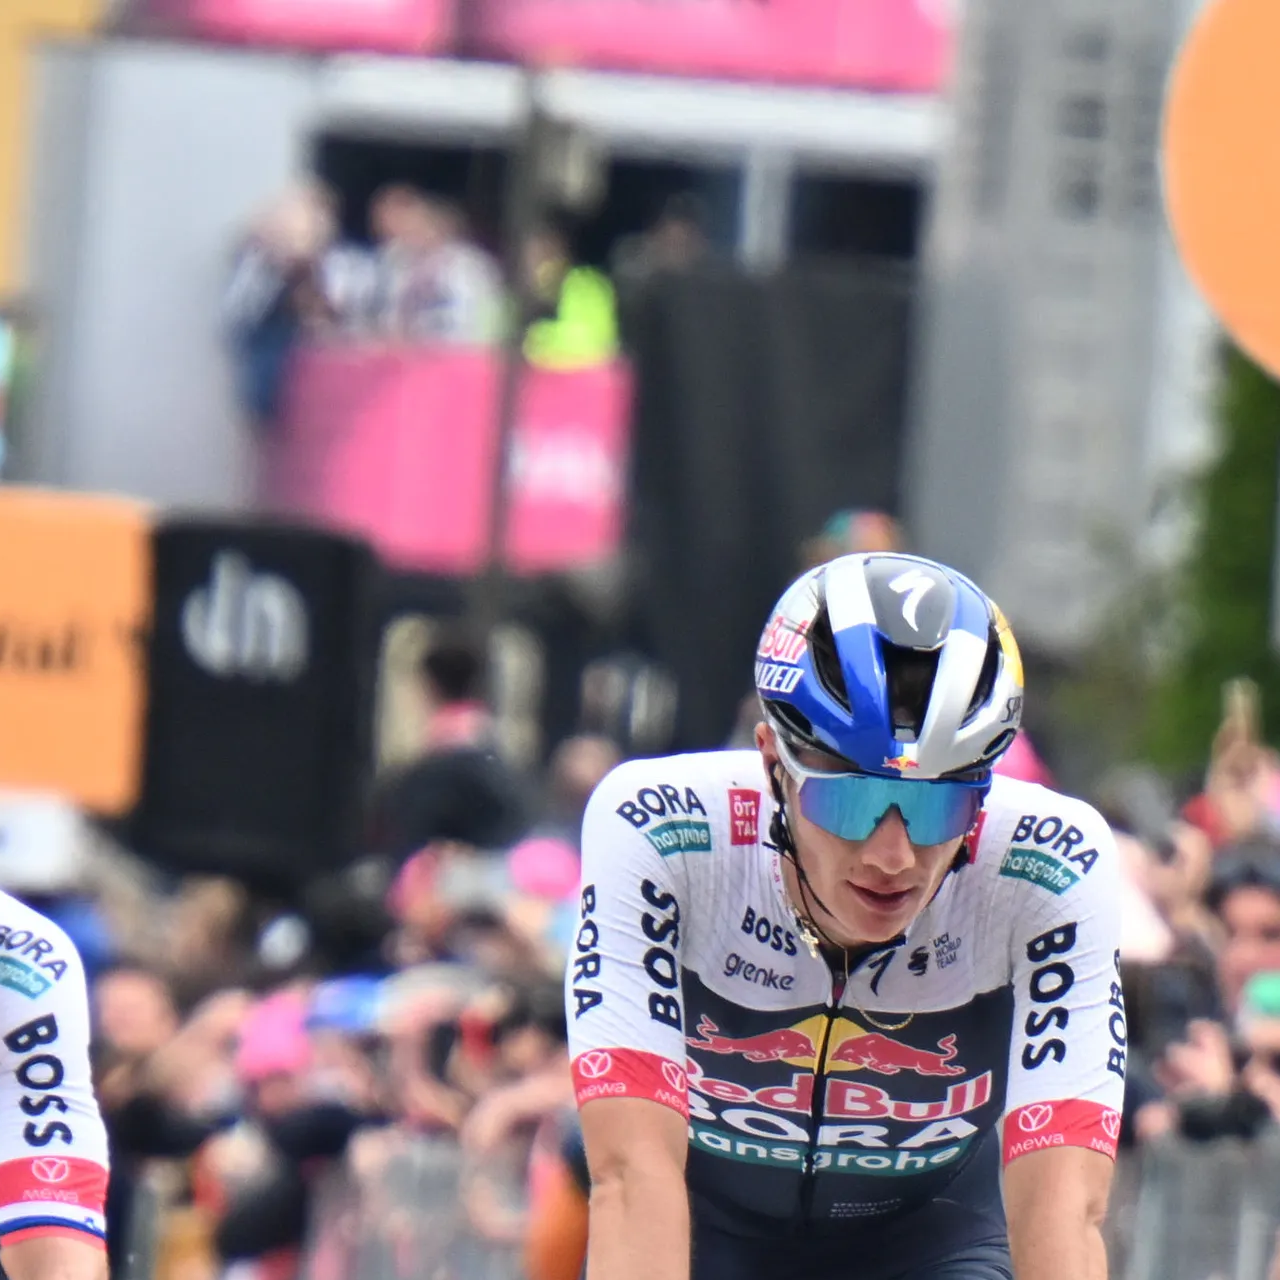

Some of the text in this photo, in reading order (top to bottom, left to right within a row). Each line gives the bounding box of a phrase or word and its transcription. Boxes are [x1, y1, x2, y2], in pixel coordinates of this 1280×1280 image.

[616, 783, 708, 829] BORA
[1012, 814, 1100, 875] BORA
[571, 884, 604, 1020] BORA
[641, 878, 682, 1031] BOSS
[740, 905, 798, 957] BOSS
[723, 952, 795, 992] grenke
[935, 953, 959, 970] TEAM
[1021, 921, 1078, 1071] BOSS
[3, 1013, 73, 1147] BOSS
[822, 1070, 994, 1121] Bull
